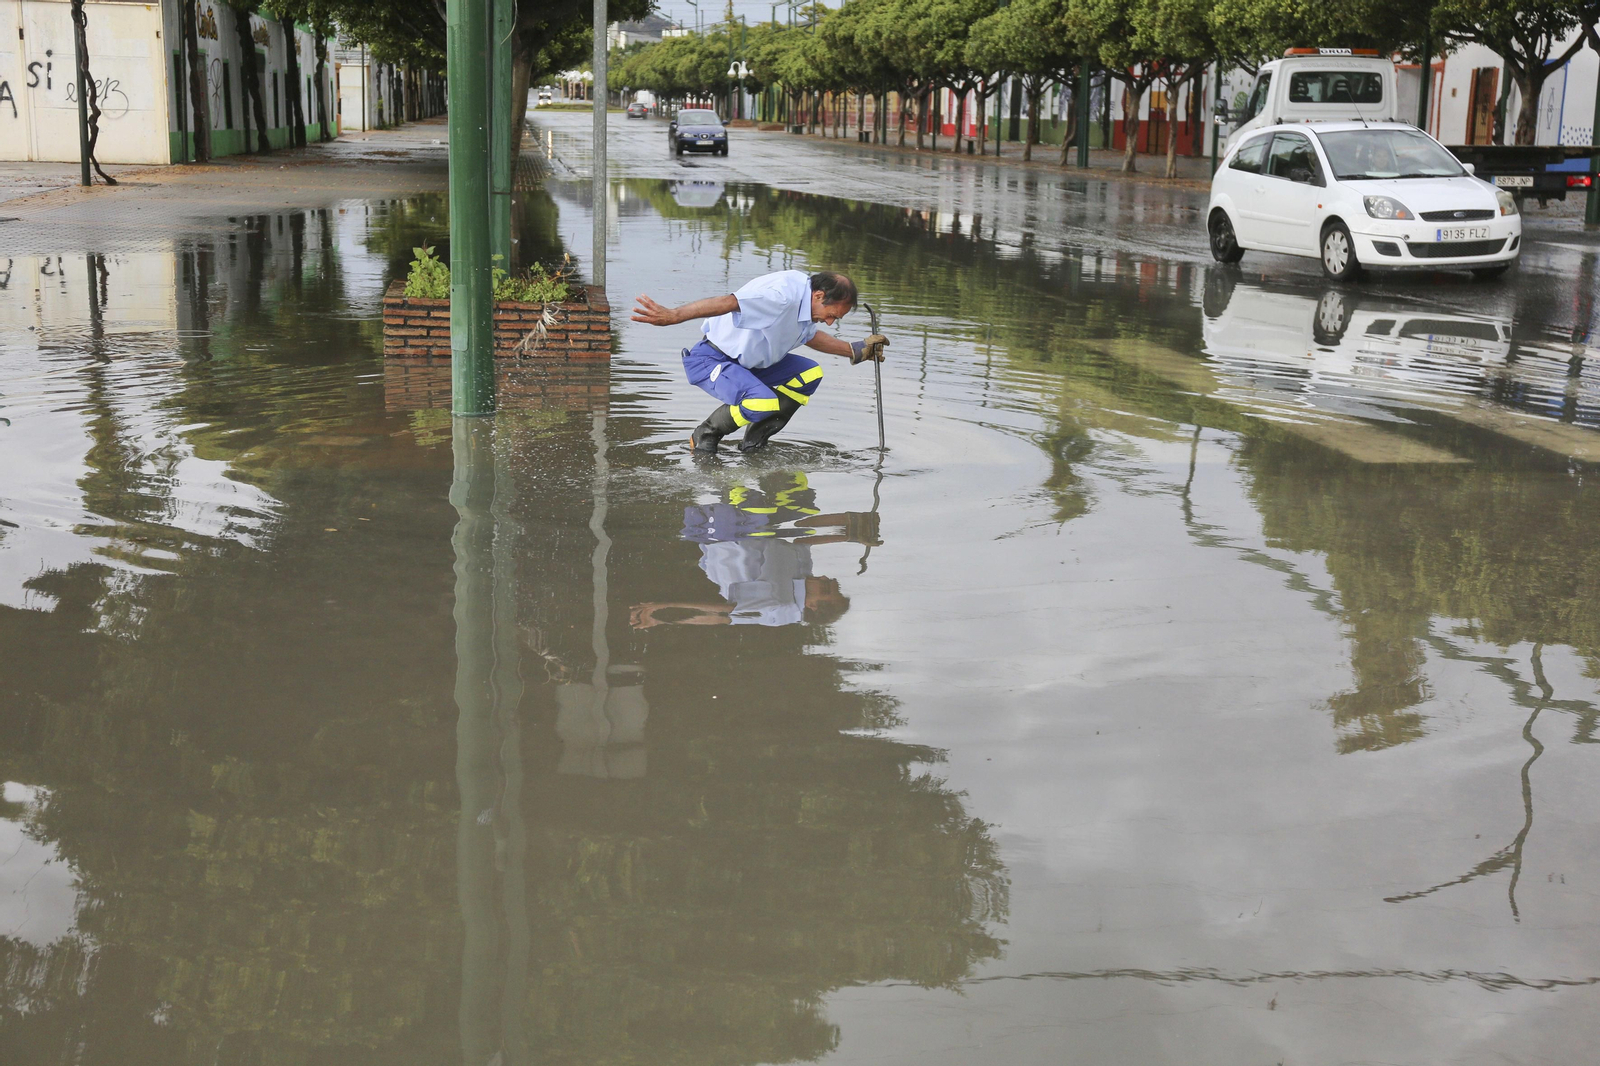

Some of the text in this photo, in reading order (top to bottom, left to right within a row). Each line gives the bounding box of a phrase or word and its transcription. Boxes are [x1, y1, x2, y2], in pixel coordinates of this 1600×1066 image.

[1497, 176, 1516, 186] 5879
[1443, 228, 1488, 240] 9135 FLZ
